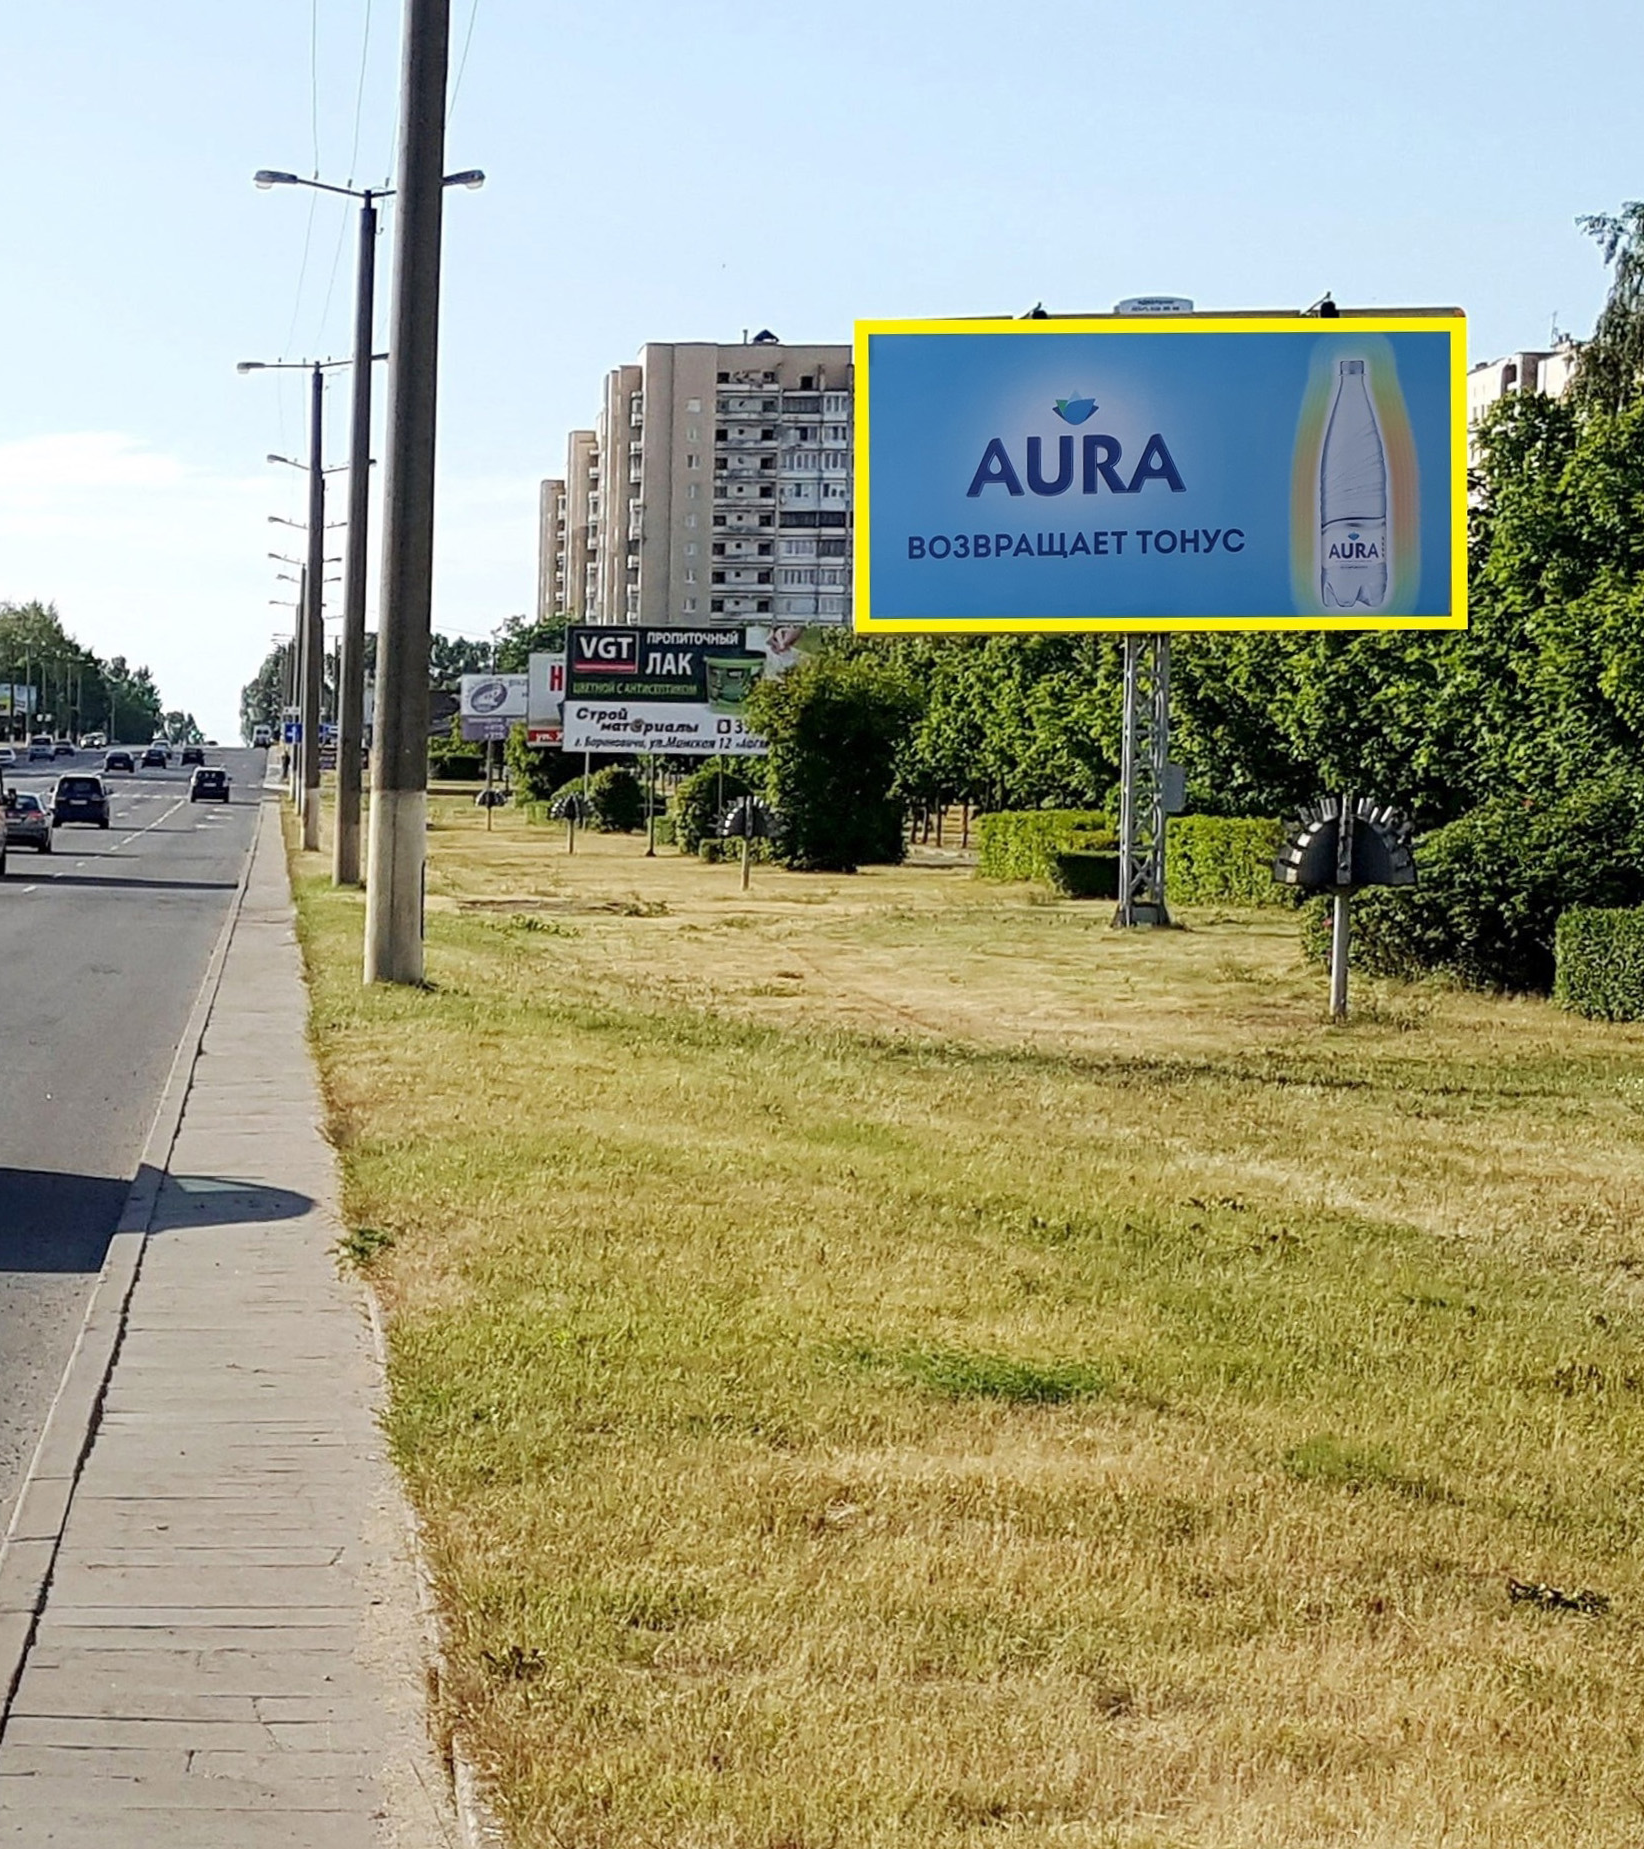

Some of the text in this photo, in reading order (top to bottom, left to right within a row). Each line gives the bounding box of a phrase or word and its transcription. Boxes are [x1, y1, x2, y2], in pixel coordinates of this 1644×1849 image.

[966, 433, 1187, 498] AURA
[908, 527, 1246, 561] ВОЗВРАЩАЕТ ТОНУС
[1328, 542, 1379, 559] AURA
[579, 636, 634, 659] VGT
[646, 631, 739, 646] ПРОПИТОЧНЫЙ
[645, 652, 693, 676] ЛАК
[576, 708, 628, 724] Строй
